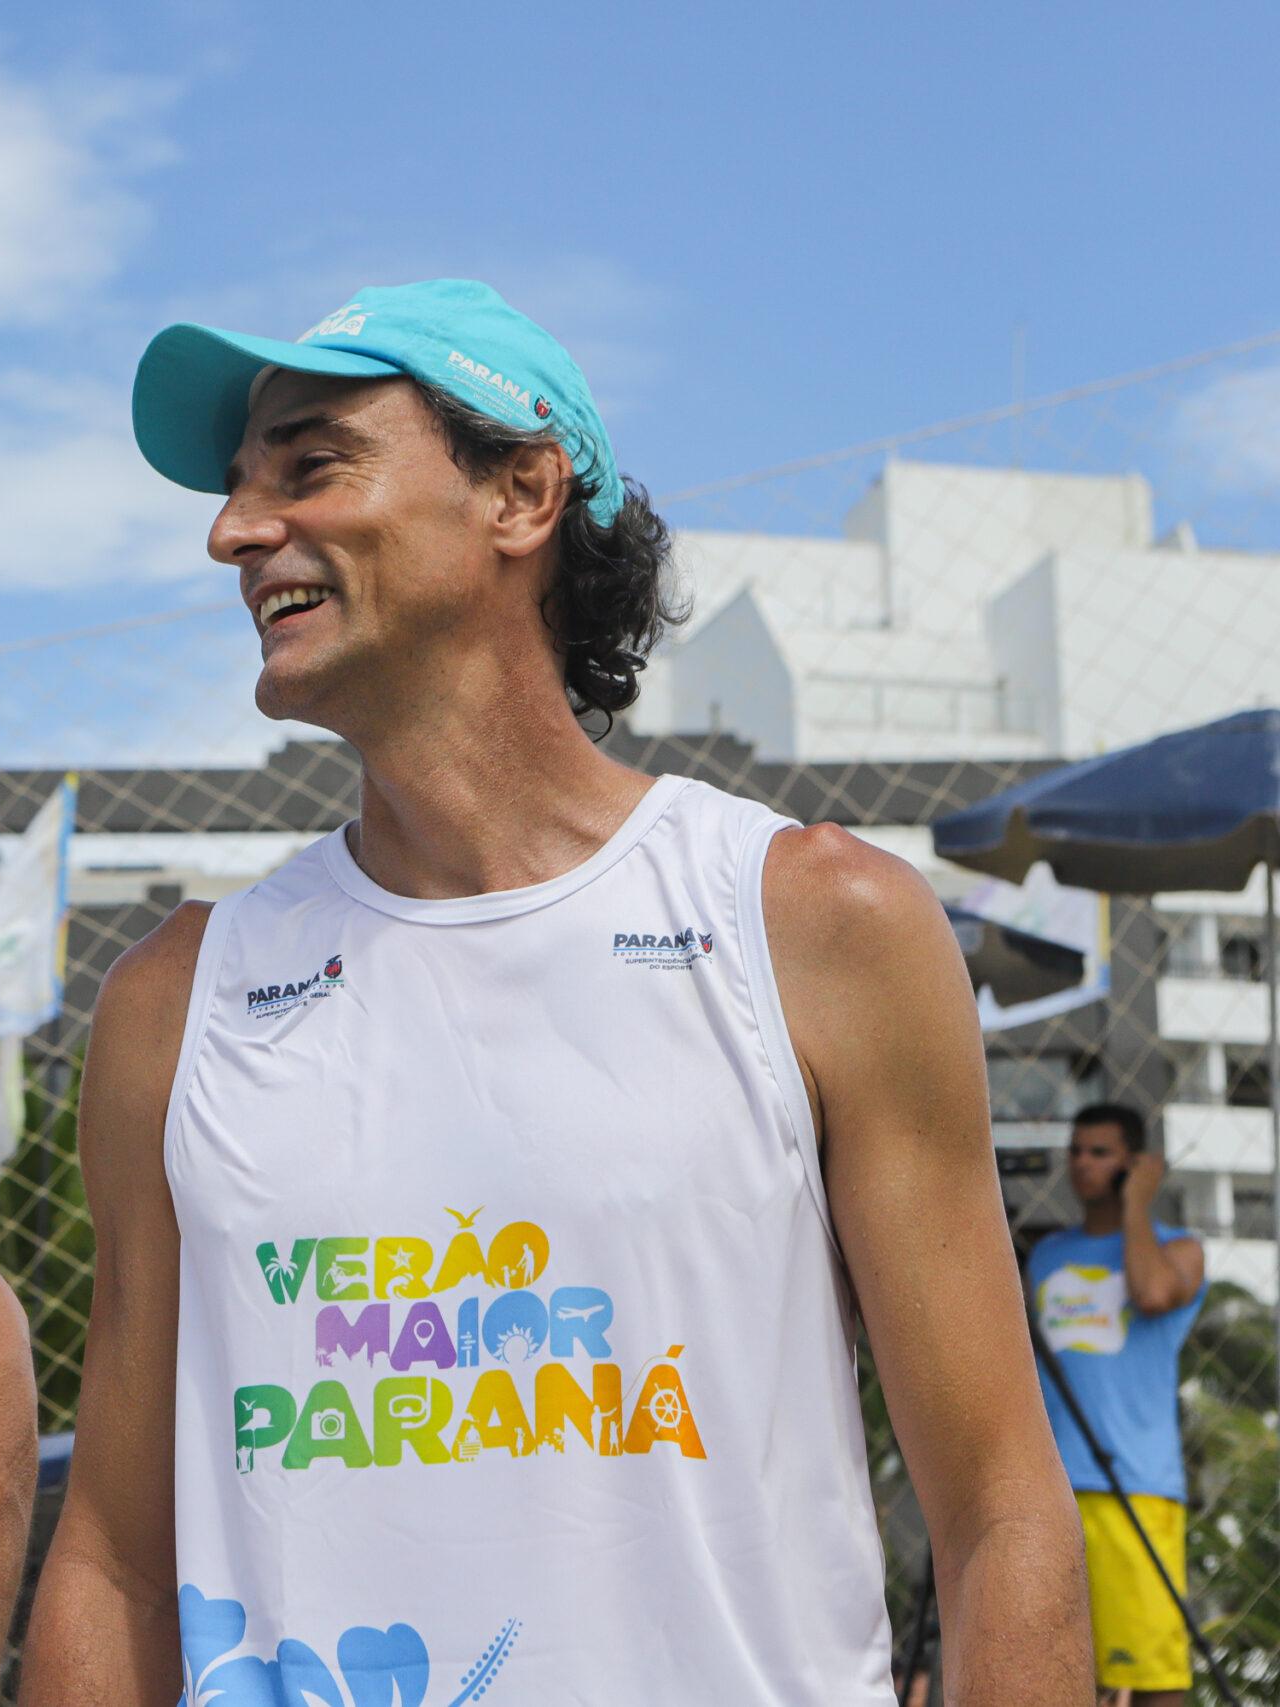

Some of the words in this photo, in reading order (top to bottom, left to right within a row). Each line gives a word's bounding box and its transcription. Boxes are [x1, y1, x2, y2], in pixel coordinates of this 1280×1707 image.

[613, 927, 697, 948] PARANÁ
[256, 1205, 550, 1305] VERÃO
[315, 1286, 614, 1371] MAIOR
[234, 1344, 707, 1474] PARANÁ
